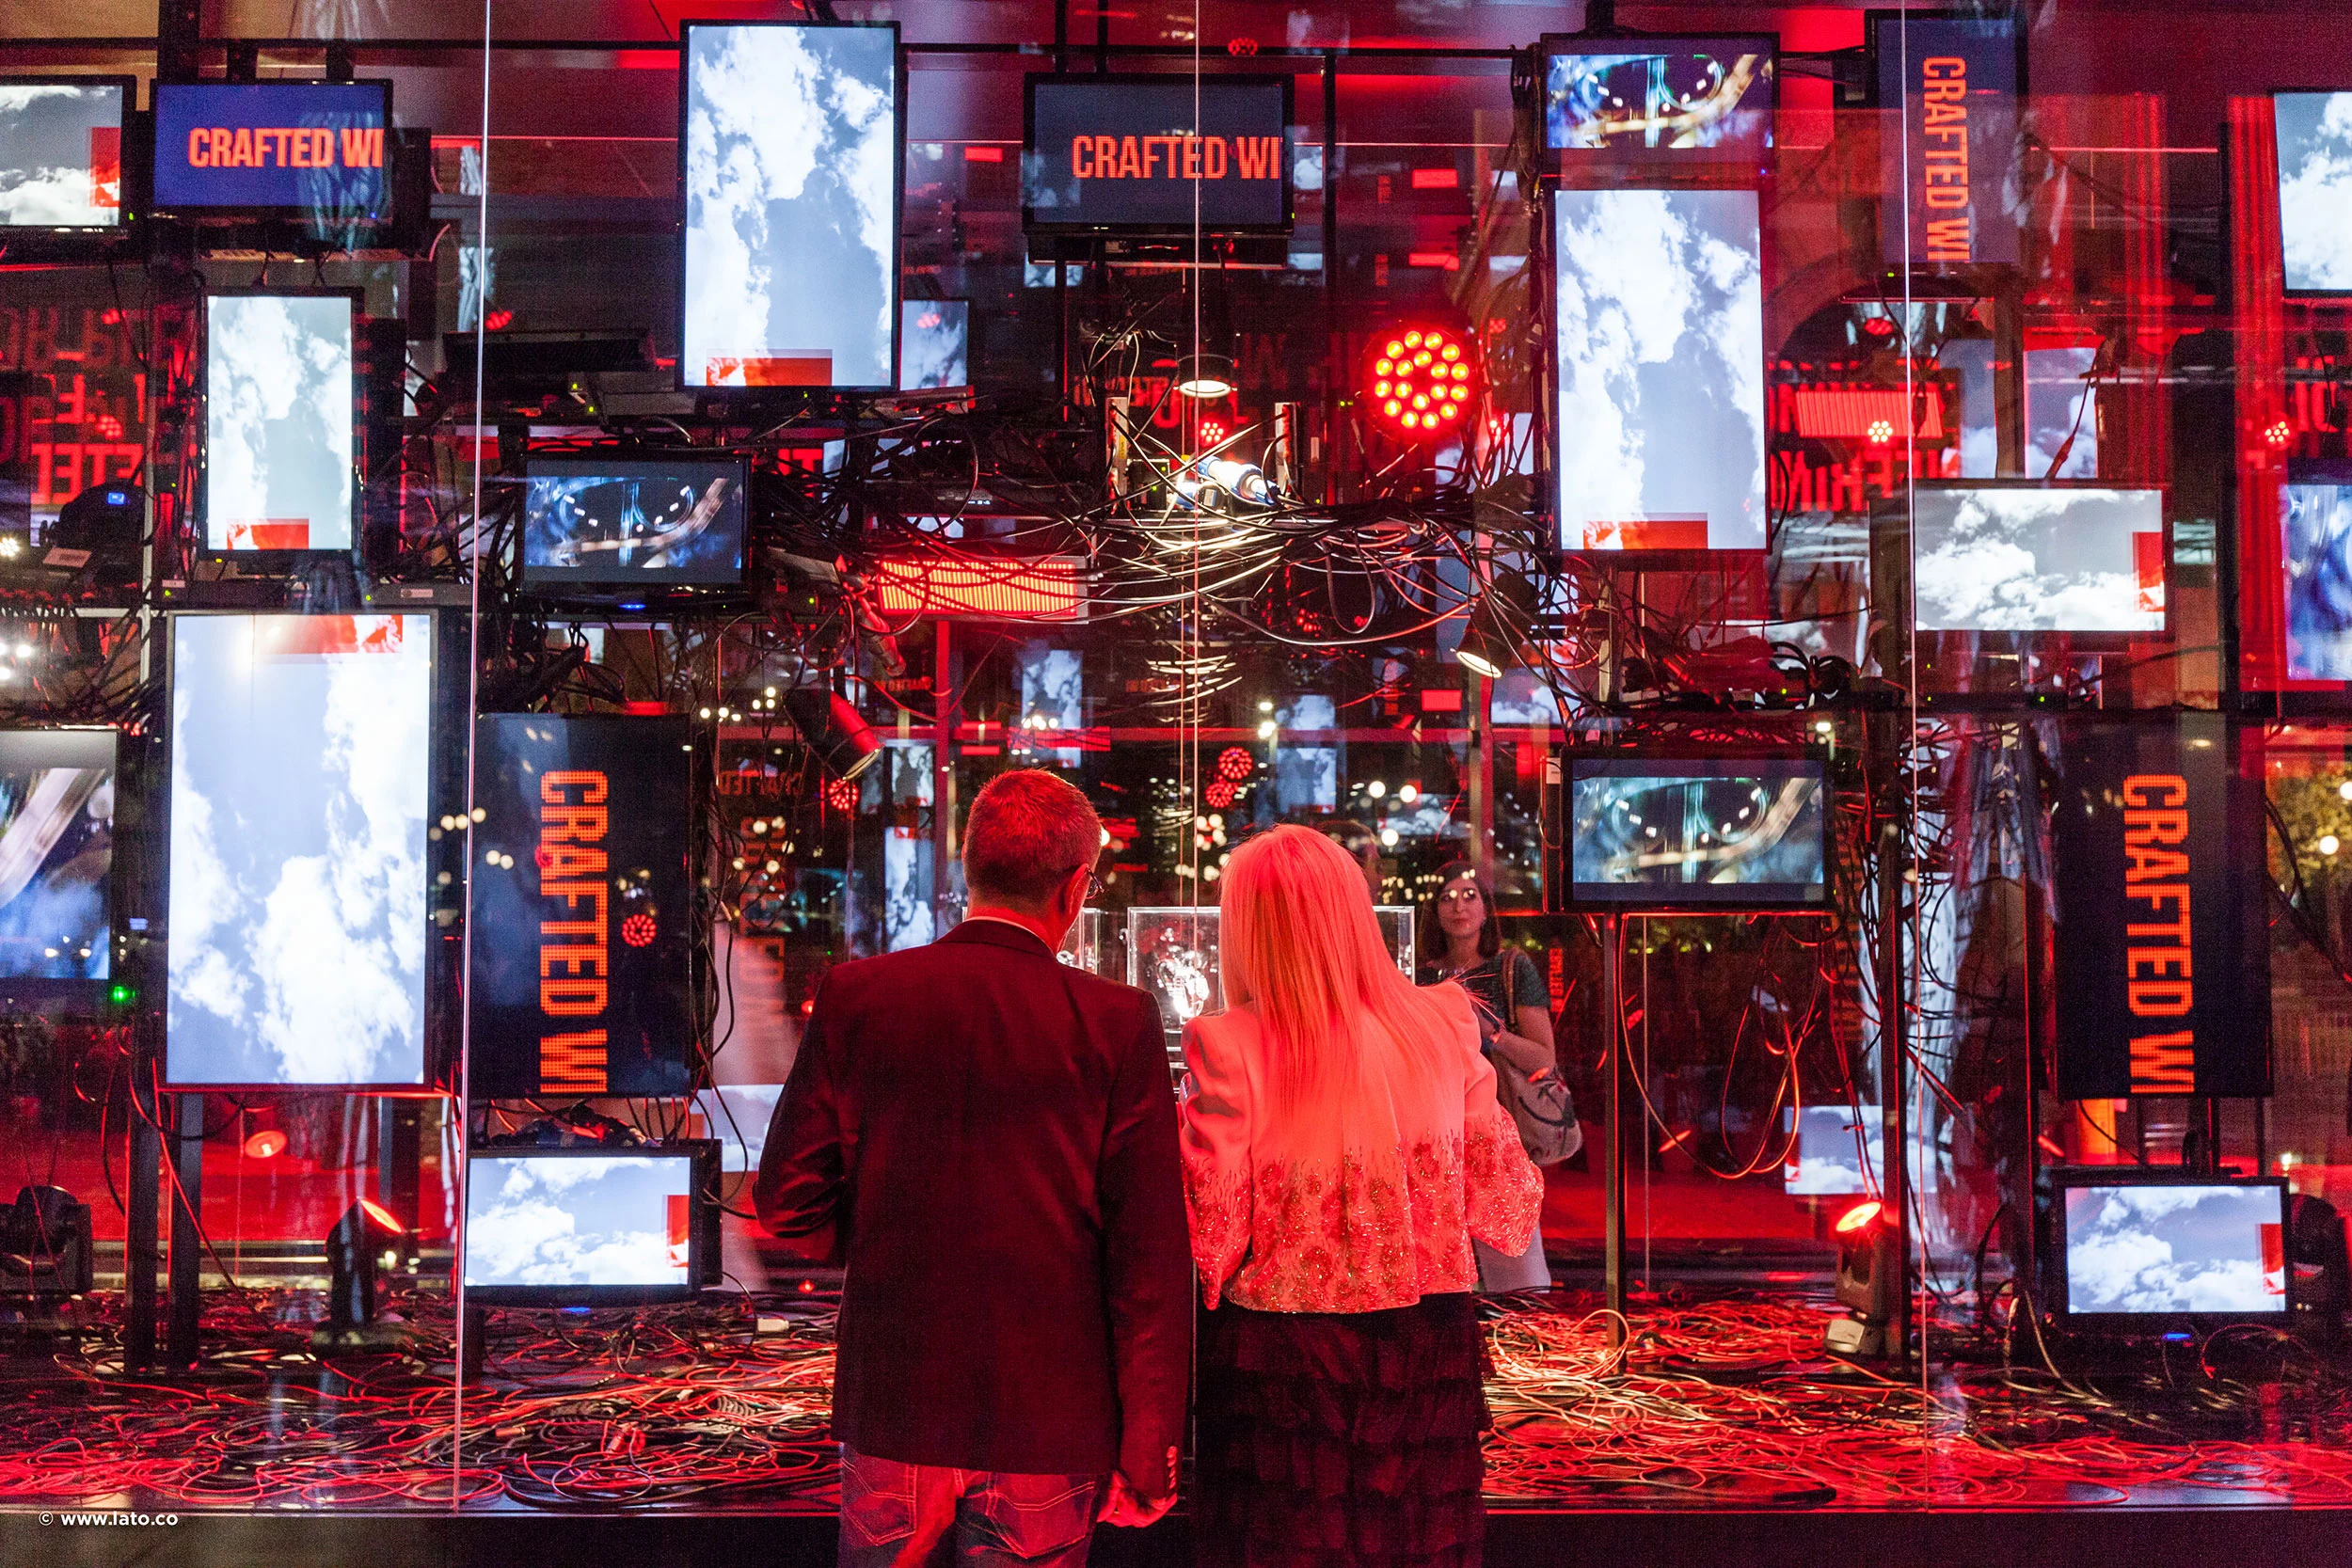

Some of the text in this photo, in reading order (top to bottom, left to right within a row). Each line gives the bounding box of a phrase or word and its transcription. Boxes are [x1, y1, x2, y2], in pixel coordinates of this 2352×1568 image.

[188, 127, 384, 168] CRAFTED WI
[1072, 135, 1281, 180] CRAFTED WI
[1923, 56, 1971, 261] CRAFTED WI
[540, 770, 608, 1093] CRAFTED WI
[2122, 774, 2196, 1094] CRAFTED WI
